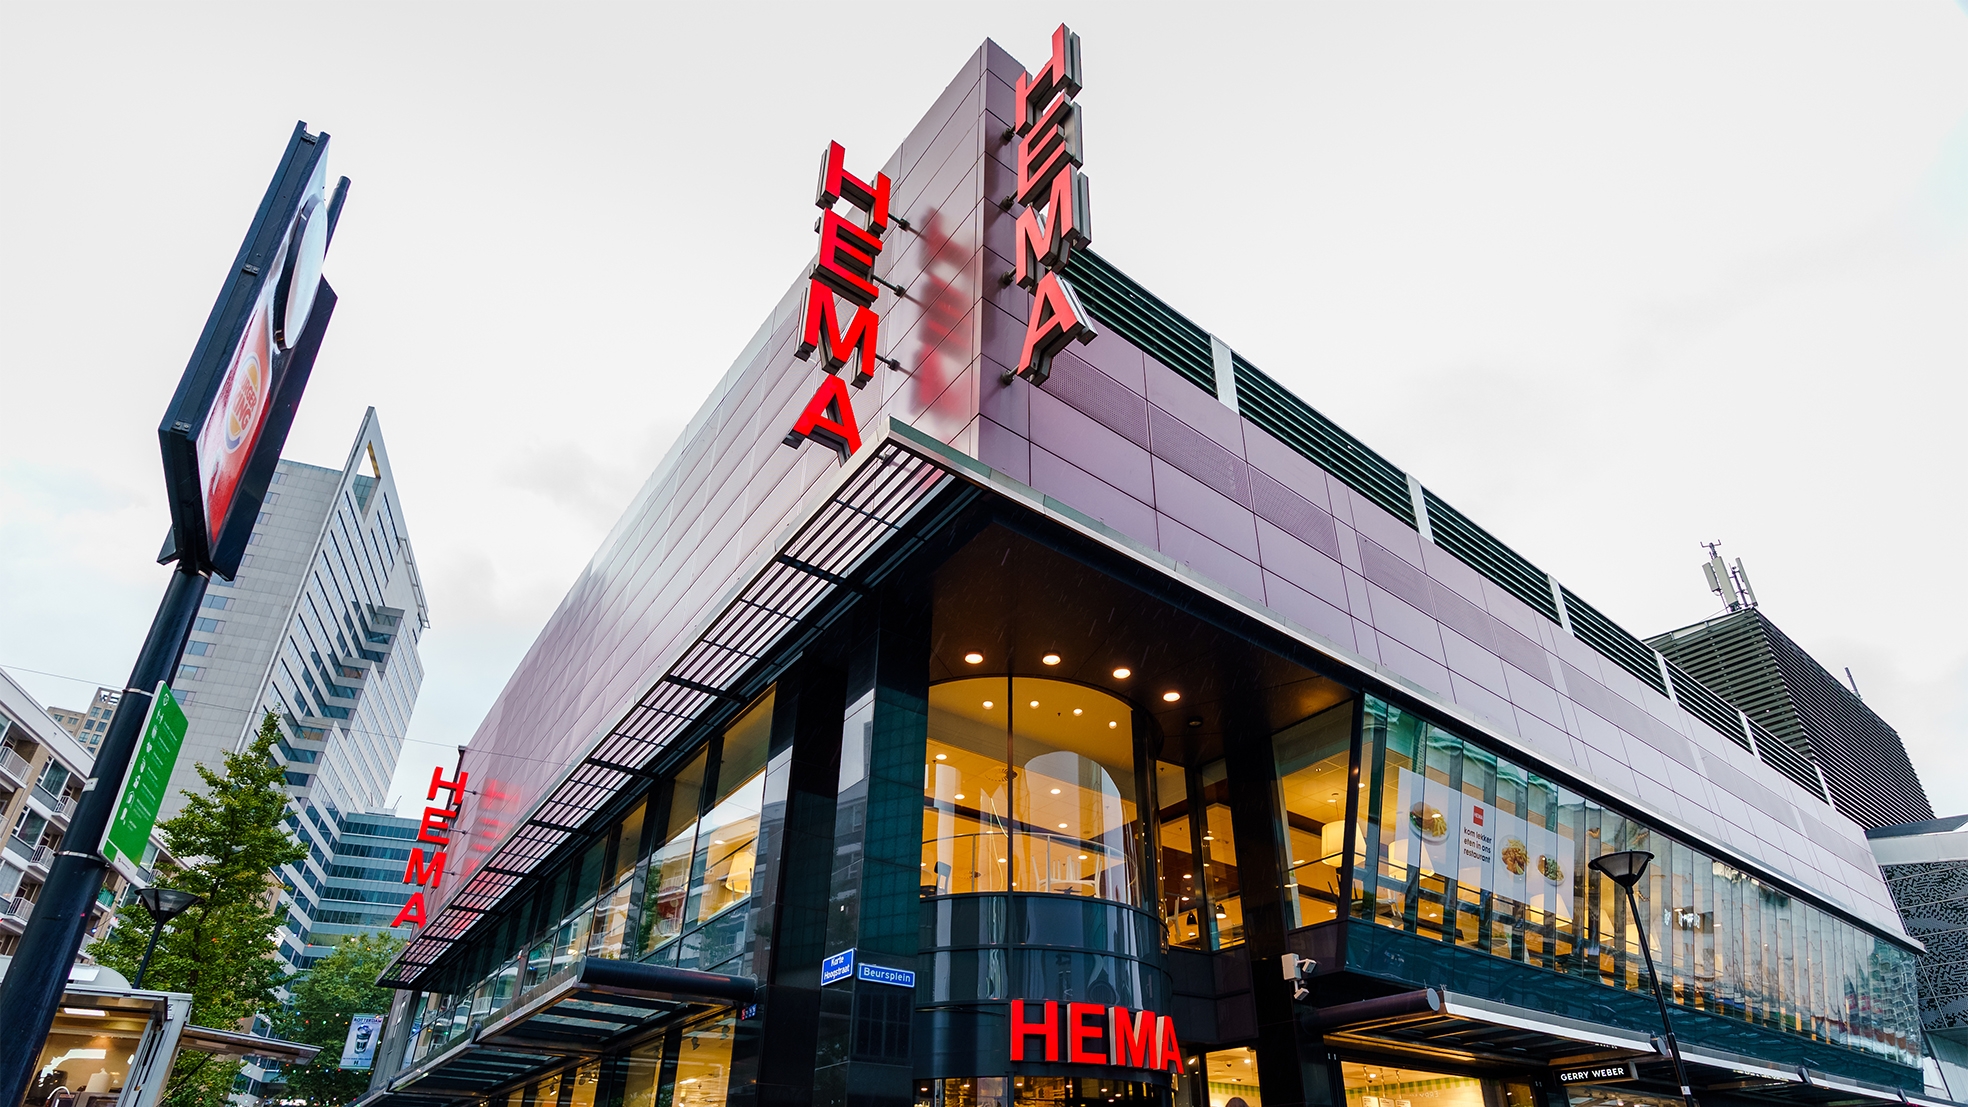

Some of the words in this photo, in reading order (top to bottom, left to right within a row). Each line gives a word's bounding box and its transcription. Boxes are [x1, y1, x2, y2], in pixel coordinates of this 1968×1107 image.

[1014, 22, 1086, 379] HEMA
[788, 138, 891, 459] HEMA
[239, 371, 257, 411] URGER
[1463, 827, 1475, 838] kom
[1475, 831, 1492, 844] lekker
[390, 766, 469, 929] HEMA
[1463, 838, 1475, 848] eten
[1476, 841, 1481, 850] in
[1481, 845, 1491, 854] ons
[1463, 848, 1490, 863] restaurant
[830, 955, 844, 967] Korte
[823, 963, 850, 980] Hoogstraat
[863, 967, 911, 982] Beursplein
[1010, 999, 1185, 1075] HEMA
[1560, 1071, 1589, 1081] GERRY
[1591, 1067, 1625, 1079] WEBER
